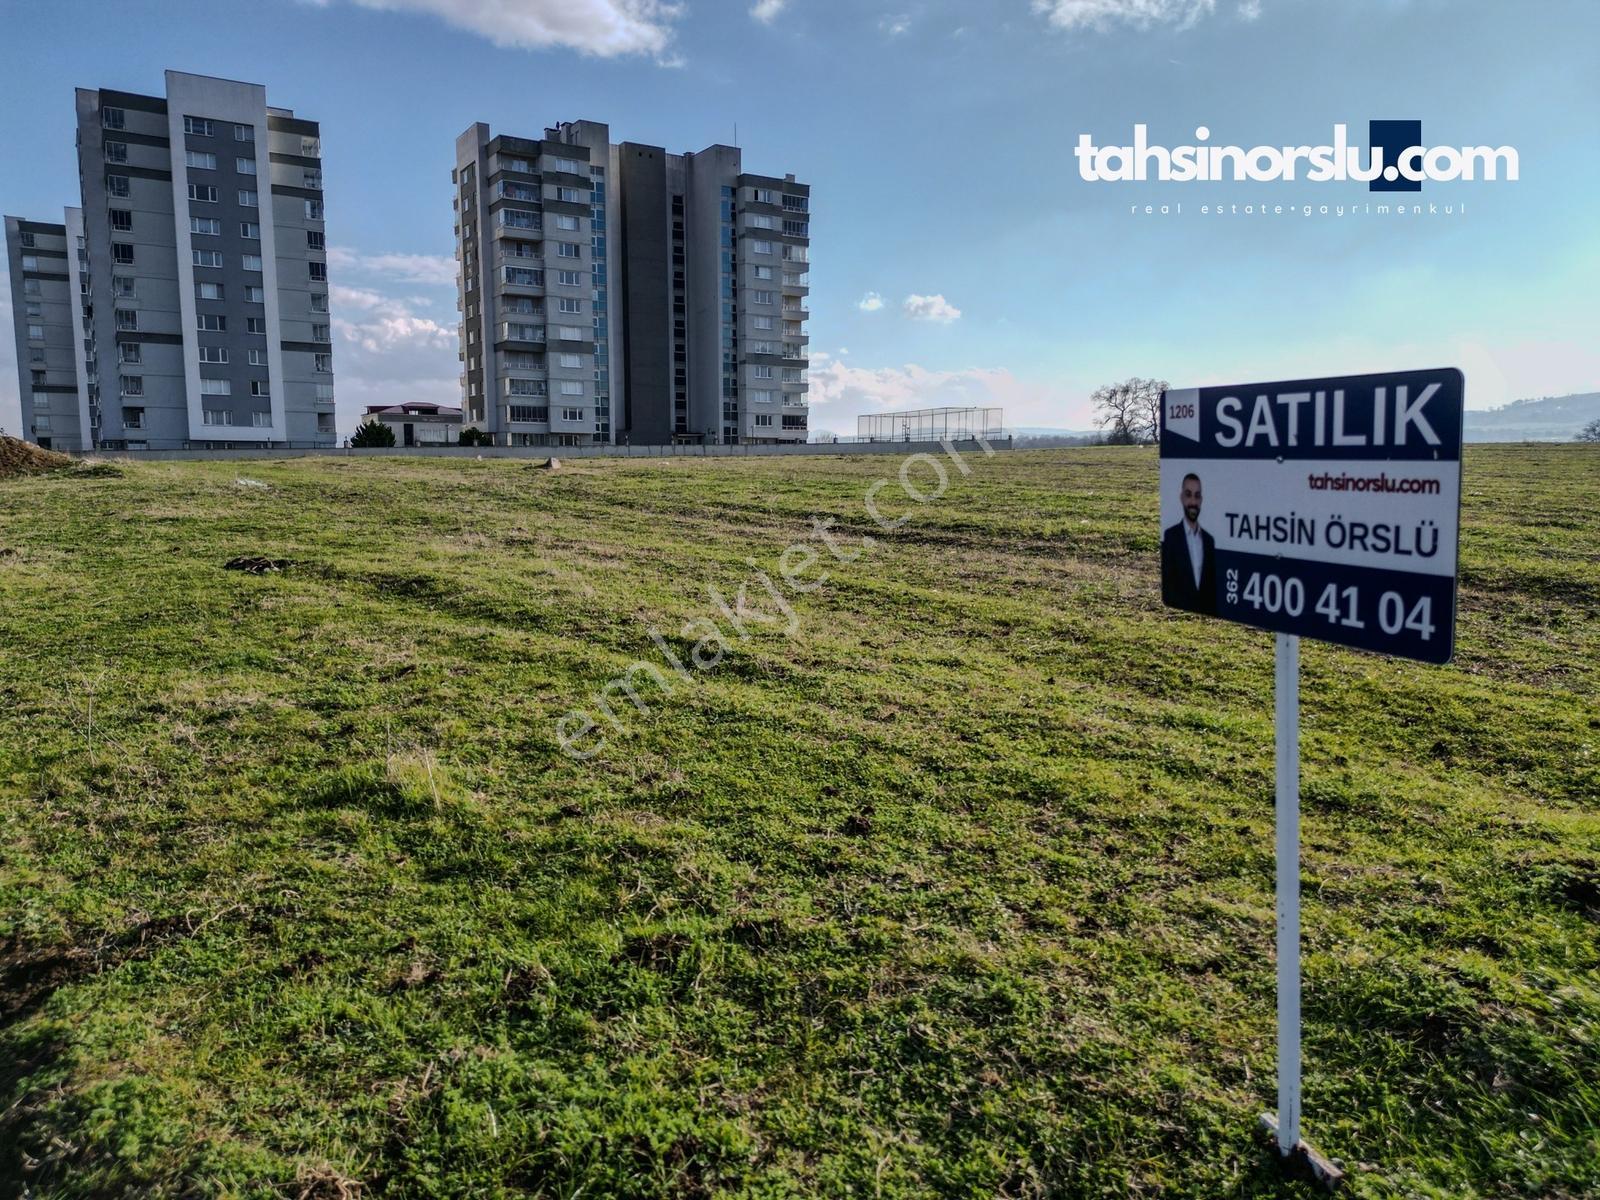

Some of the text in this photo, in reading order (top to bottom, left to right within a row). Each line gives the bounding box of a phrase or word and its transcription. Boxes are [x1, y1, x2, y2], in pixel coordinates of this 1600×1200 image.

[1169, 404, 1195, 419] 1206
[1214, 383, 1442, 448] SATILIK
[1308, 472, 1441, 494] tahsinorslu.com
[1225, 511, 1439, 558] TAHSİN ÖRSLÜ
[1226, 568, 1436, 641] 362 400 41 04
